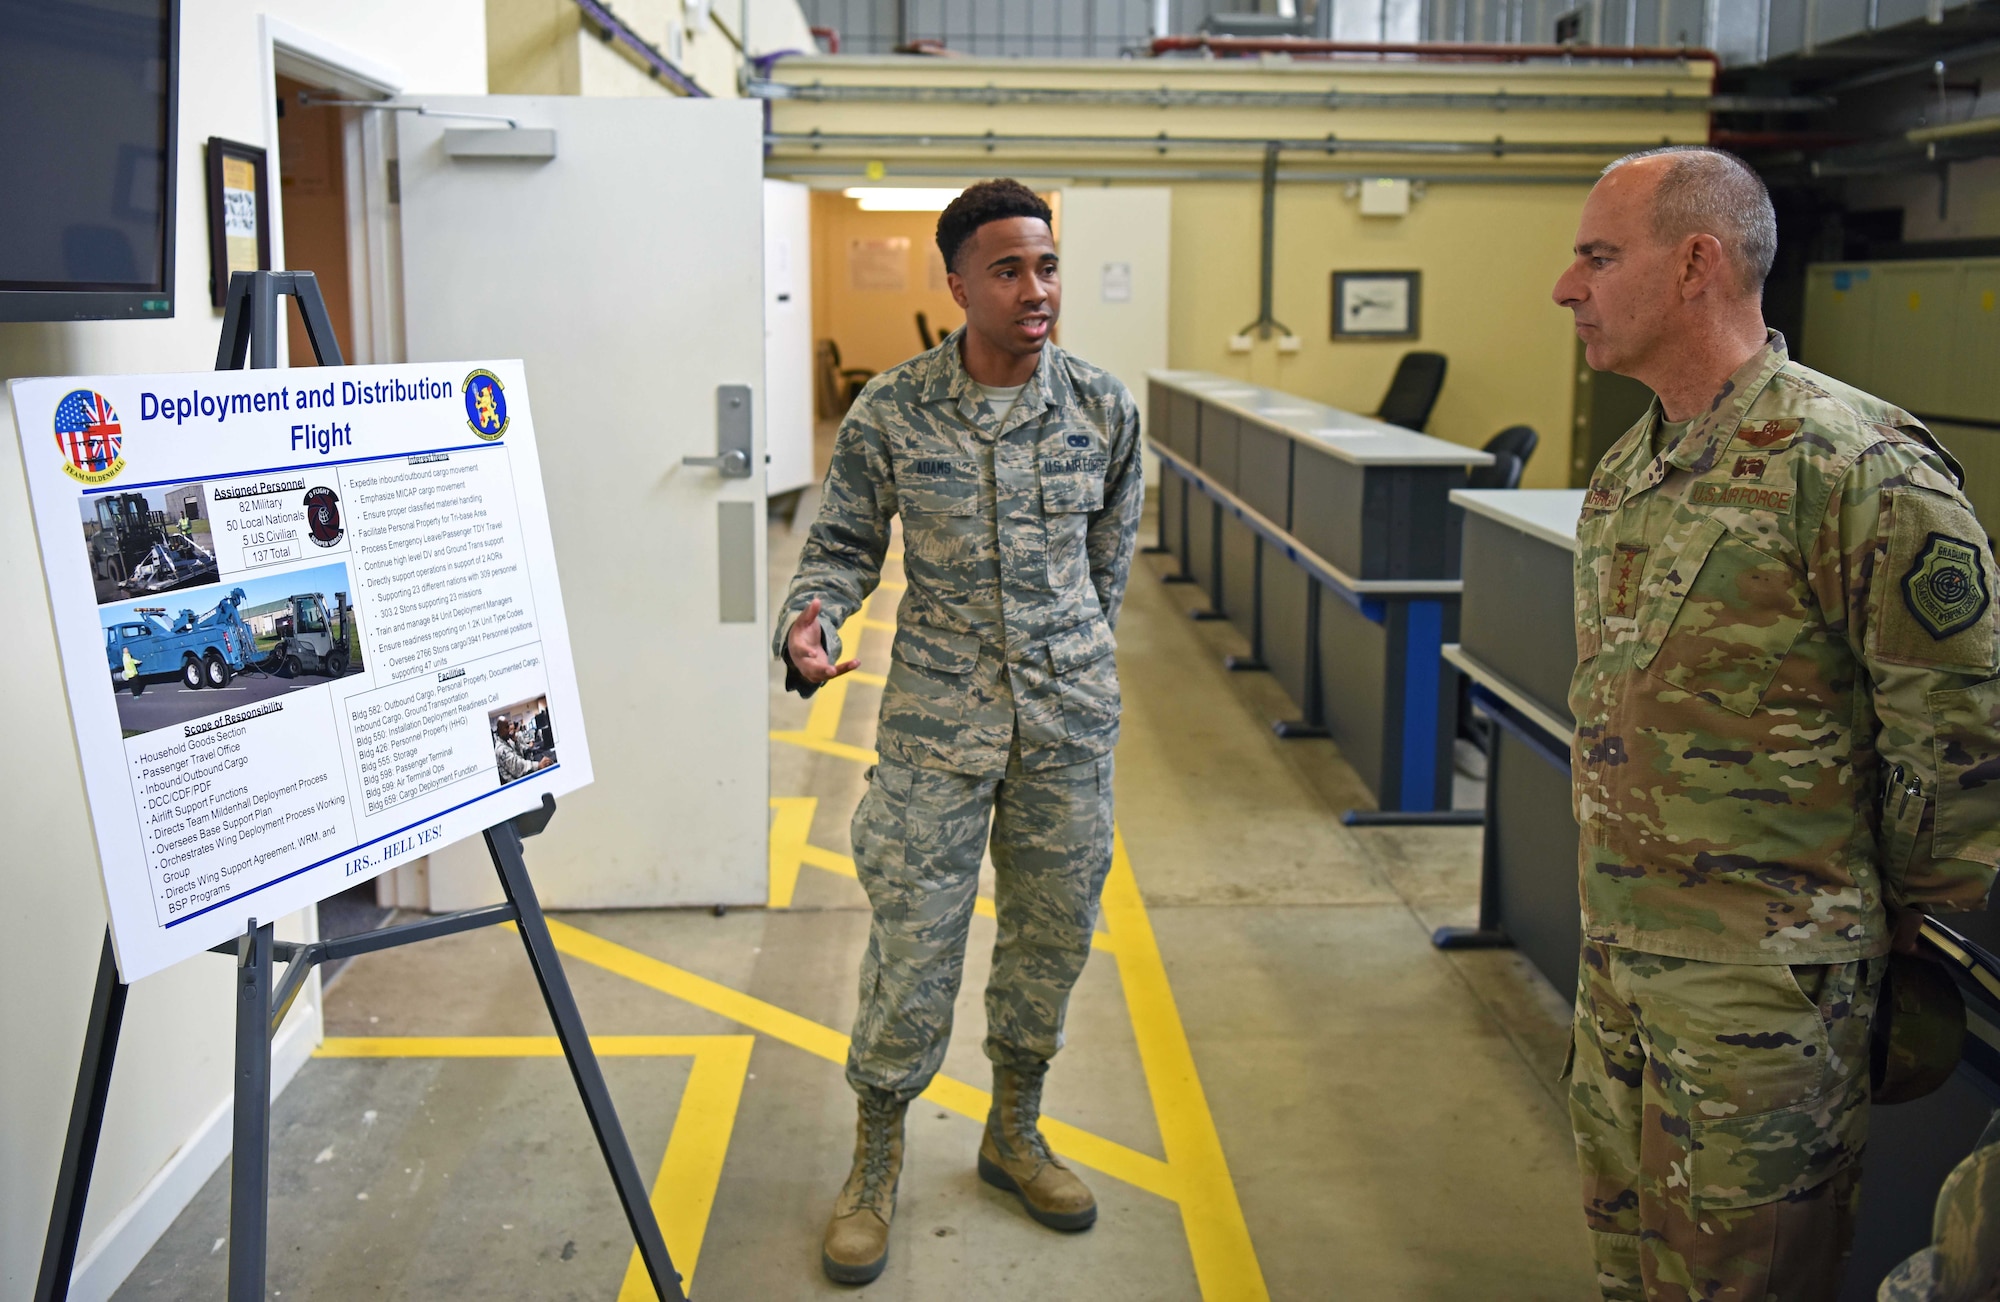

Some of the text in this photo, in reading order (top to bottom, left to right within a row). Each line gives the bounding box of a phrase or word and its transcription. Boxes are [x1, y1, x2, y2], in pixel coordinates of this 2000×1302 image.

[140, 387, 289, 426] Deployment
[296, 382, 335, 409] and
[342, 377, 453, 406] Distribution
[290, 421, 352, 454] Flight
[66, 460, 124, 482] TEAM MILDENHALL
[350, 464, 478, 488] Expedite inbound/outbound cargo movement
[917, 461, 951, 475] ADAMS
[1044, 458, 1108, 474] U.S. AIR FORCE
[214, 477, 306, 501] Assigned Personnel
[360, 482, 465, 504] Emphasize MICAP cargo movement
[1692, 486, 1791, 510] U.S. AIR FORCE
[239, 499, 282, 512] 82 Military
[363, 511, 386, 520] Ensure
[387, 507, 406, 518] proper
[408, 502, 435, 512] classified
[459, 495, 482, 504] handling
[227, 511, 305, 531] 50 Local Nationals
[359, 527, 387, 537] Facilitate
[388, 521, 415, 532] Personal
[416, 518, 440, 528] Property
[243, 529, 297, 545] 5 US Civilian
[361, 522, 502, 554] Process Emergency Leave/Passenger TDY Travel
[253, 547, 290, 562] 137 Total
[1938, 546, 1972, 562] GRADUATE
[381, 589, 482, 618] 303.2 Stons supporting 23 missions
[438, 667, 466, 683] Facilities
[352, 710, 367, 721] Bldg
[384, 695, 415, 710] Outbound
[437, 680, 462, 694] Personal
[489, 662, 522, 678] Documented
[184, 700, 283, 738] Scope of Responsibility
[355, 718, 381, 733] Inbound
[405, 703, 427, 717] Ground
[428, 692, 468, 710] Transportation
[357, 736, 372, 747] Bldg
[389, 720, 421, 736] Installation
[423, 708, 457, 725] Deployment
[458, 699, 487, 713] Readiness
[488, 693, 499, 703] Cell
[140, 727, 246, 764] Household Goods Section
[359, 749, 374, 760] Bldg
[391, 732, 422, 749] Personnel
[423, 725, 448, 738] Property
[449, 716, 468, 730] (HHG)
[143, 744, 240, 779] Passenger Travel Office
[146, 757, 248, 794] Inbound/Outbound Cargo
[362, 762, 377, 773] Bldg
[393, 748, 417, 761] Storage
[364, 775, 379, 786] Bldg
[396, 757, 428, 774] Passenger
[429, 747, 453, 762] Terminal
[149, 780, 211, 809] DCC/CDF/PDF
[366, 788, 381, 798] Bldg
[397, 778, 405, 787] Air
[406, 768, 431, 783] Terminal
[432, 764, 445, 774] Ops
[369, 801, 383, 811] Bldg
[399, 788, 418, 799] Cargo
[419, 773, 453, 792] Deployment
[454, 765, 478, 778] Function
[152, 786, 248, 824] Airlift Support Functions
[154, 774, 327, 839] Directs Team Mildenhall Deployment Process
[157, 808, 272, 854] Oversees Base Support Plan
[160, 796, 345, 868] Orchestrates Wing Deployment Process Working
[166, 882, 196, 898] Directs
[197, 873, 219, 886] Wing
[221, 858, 252, 877] Support
[323, 825, 335, 838] and
[346, 824, 442, 877] LRS... HELL YES!
[163, 868, 190, 883] Group
[169, 884, 230, 913] BSP Programs
